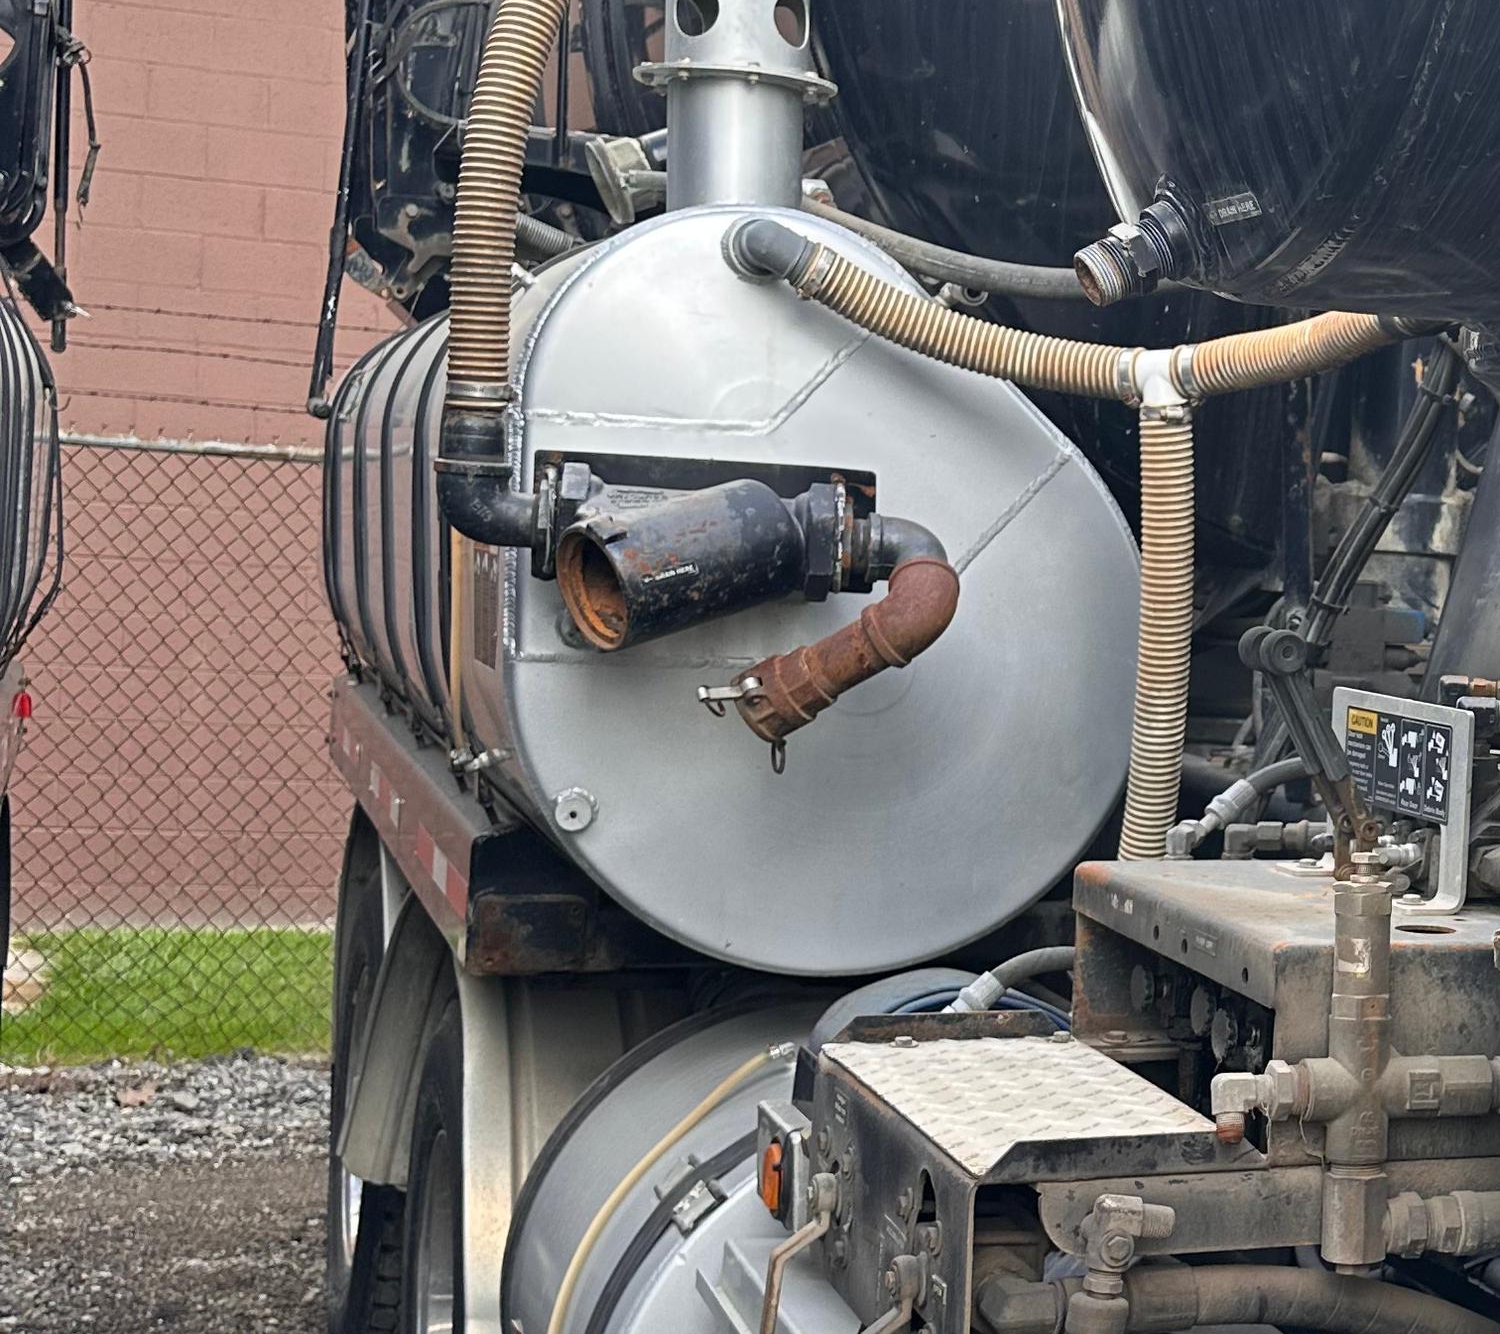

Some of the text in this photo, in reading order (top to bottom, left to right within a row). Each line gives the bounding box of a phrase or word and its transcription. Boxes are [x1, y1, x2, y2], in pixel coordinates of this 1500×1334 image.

[1218, 200, 1256, 219] DRAIN HERE
[676, 564, 693, 575] HERE
[1351, 714, 1373, 728] CAUTION
